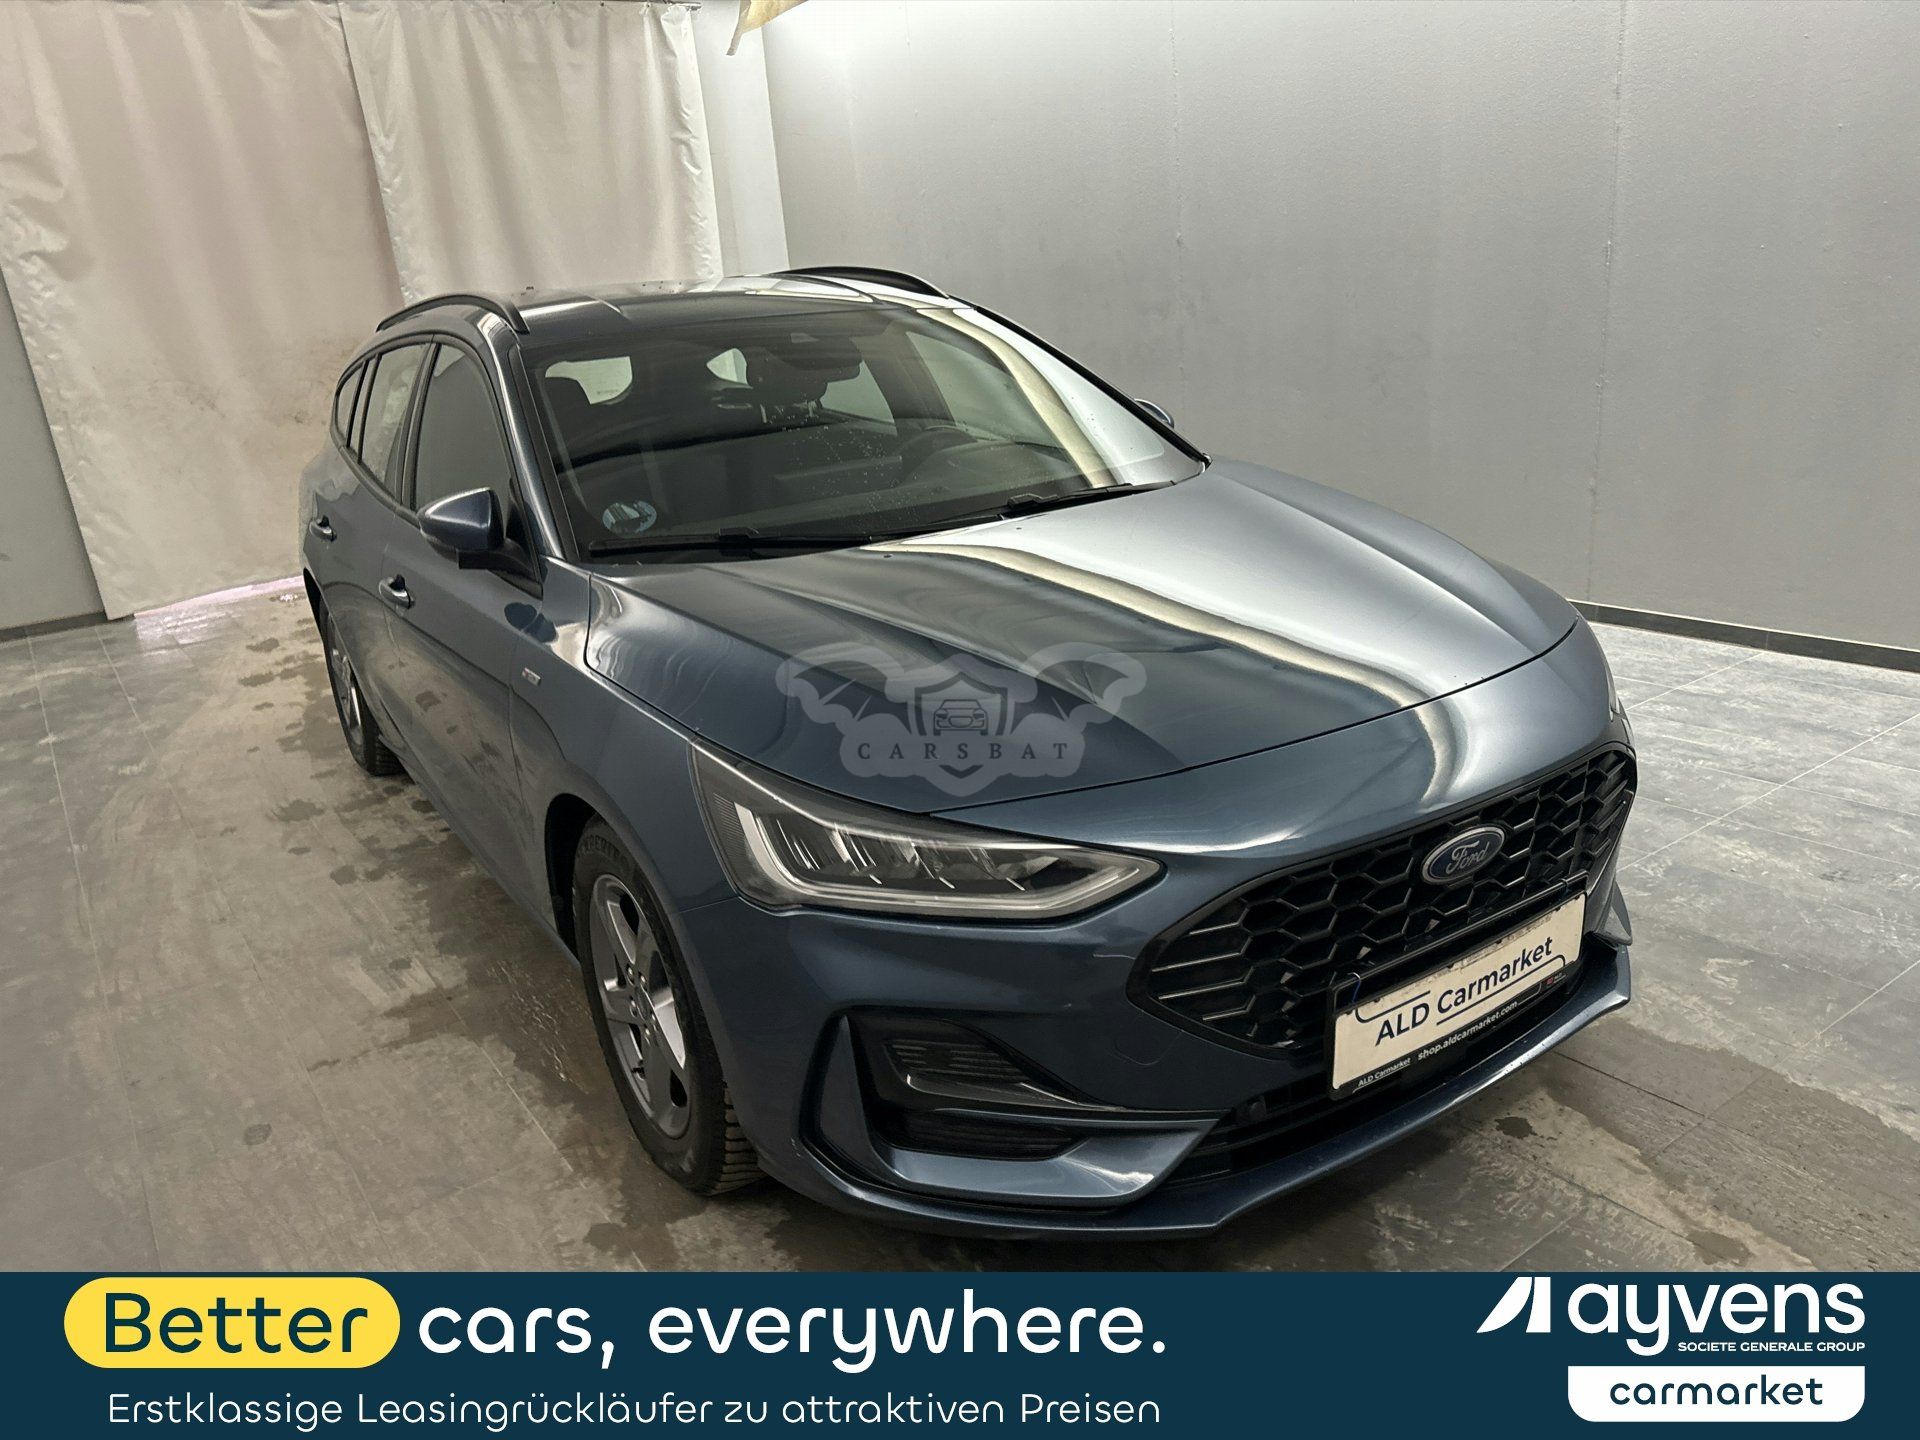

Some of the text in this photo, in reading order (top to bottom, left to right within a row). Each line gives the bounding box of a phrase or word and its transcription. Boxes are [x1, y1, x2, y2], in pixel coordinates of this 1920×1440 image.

[1446, 841, 1489, 875] Ford
[1375, 937, 1553, 1046] ALD Carmarket
[1417, 1001, 1518, 1061] shop.aldcarmarket.com
[1357, 1057, 1411, 1087] ALD Carmarket
